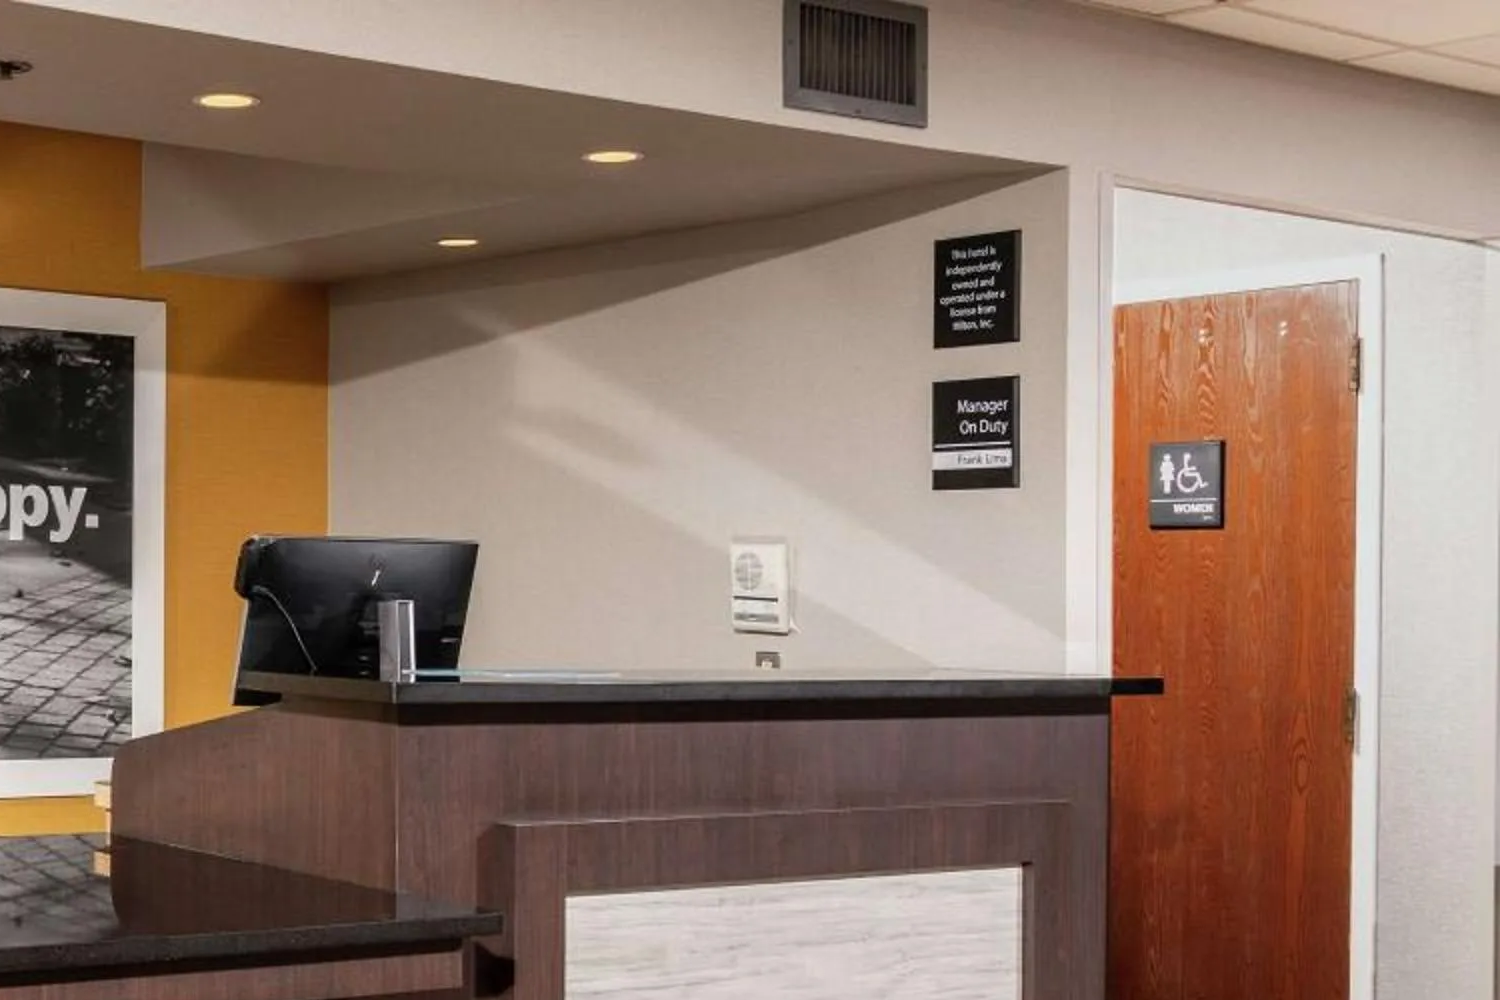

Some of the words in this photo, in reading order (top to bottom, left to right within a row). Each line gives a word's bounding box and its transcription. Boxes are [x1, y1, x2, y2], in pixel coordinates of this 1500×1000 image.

[967, 244, 989, 258] hotel
[945, 259, 1003, 278] independently
[951, 277, 978, 291] owned
[979, 275, 995, 287] and
[939, 291, 975, 306] operated
[975, 289, 999, 301] under
[949, 306, 976, 318] license
[957, 399, 1009, 415] Manager
[959, 419, 977, 435] On
[979, 418, 1009, 435] Duty
[1173, 503, 1215, 514] WOMEN
